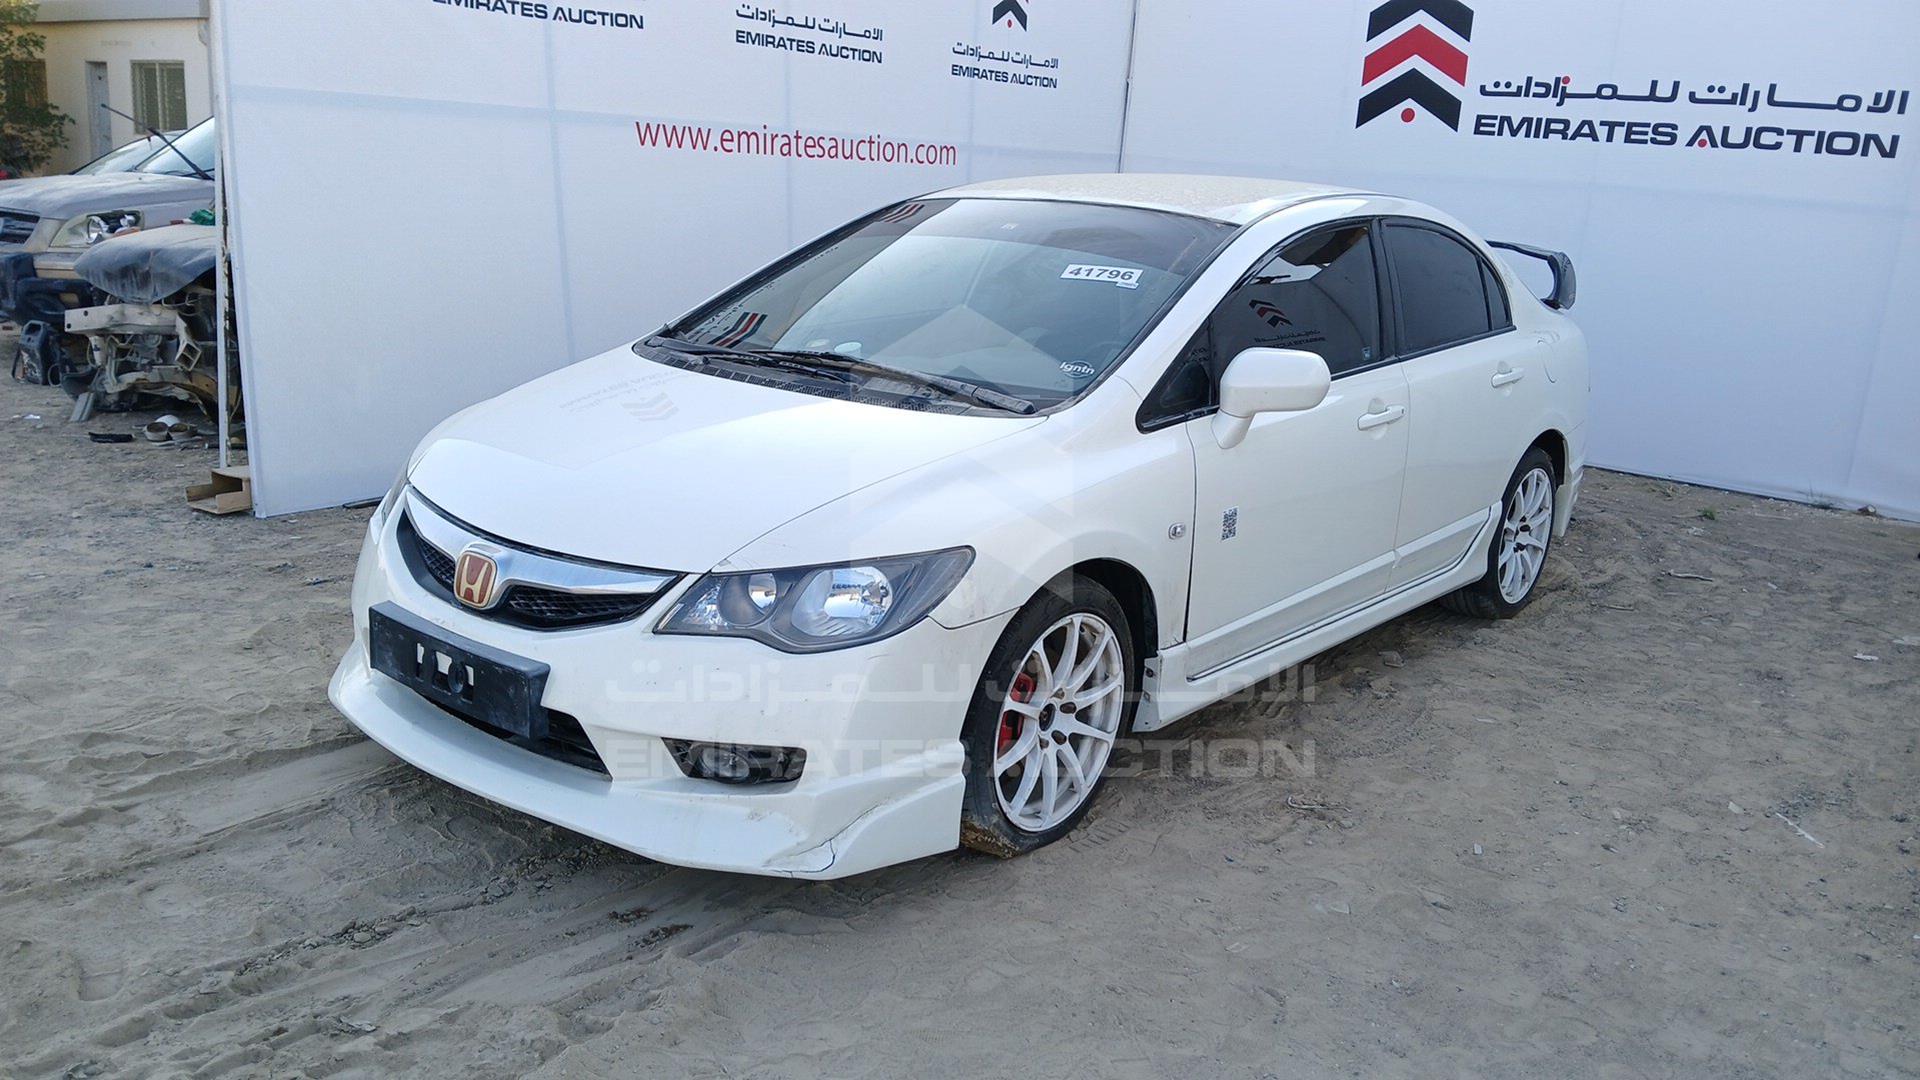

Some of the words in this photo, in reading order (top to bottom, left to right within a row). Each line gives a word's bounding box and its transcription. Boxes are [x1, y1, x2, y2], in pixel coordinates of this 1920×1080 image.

[432, 0, 548, 19] IRATES
[552, 6, 645, 29] AUCTION
[735, 3, 816, 28] للمزادات
[818, 17, 883, 41] الامارات
[735, 29, 815, 54] EMIRATES
[817, 43, 883, 63] AUCTION
[952, 42, 1010, 62] للمزادات
[951, 64, 1009, 83] EMIRATES
[1010, 73, 1058, 88] AUCTION
[1479, 75, 1681, 107] للمزادات
[1688, 83, 1910, 115] الامارات
[635, 121, 957, 166] www.emiratesauction.com
[1473, 114, 1679, 146] EMIRATES
[1685, 125, 1901, 159] AUCTION
[1069, 267, 1135, 281] 41796
